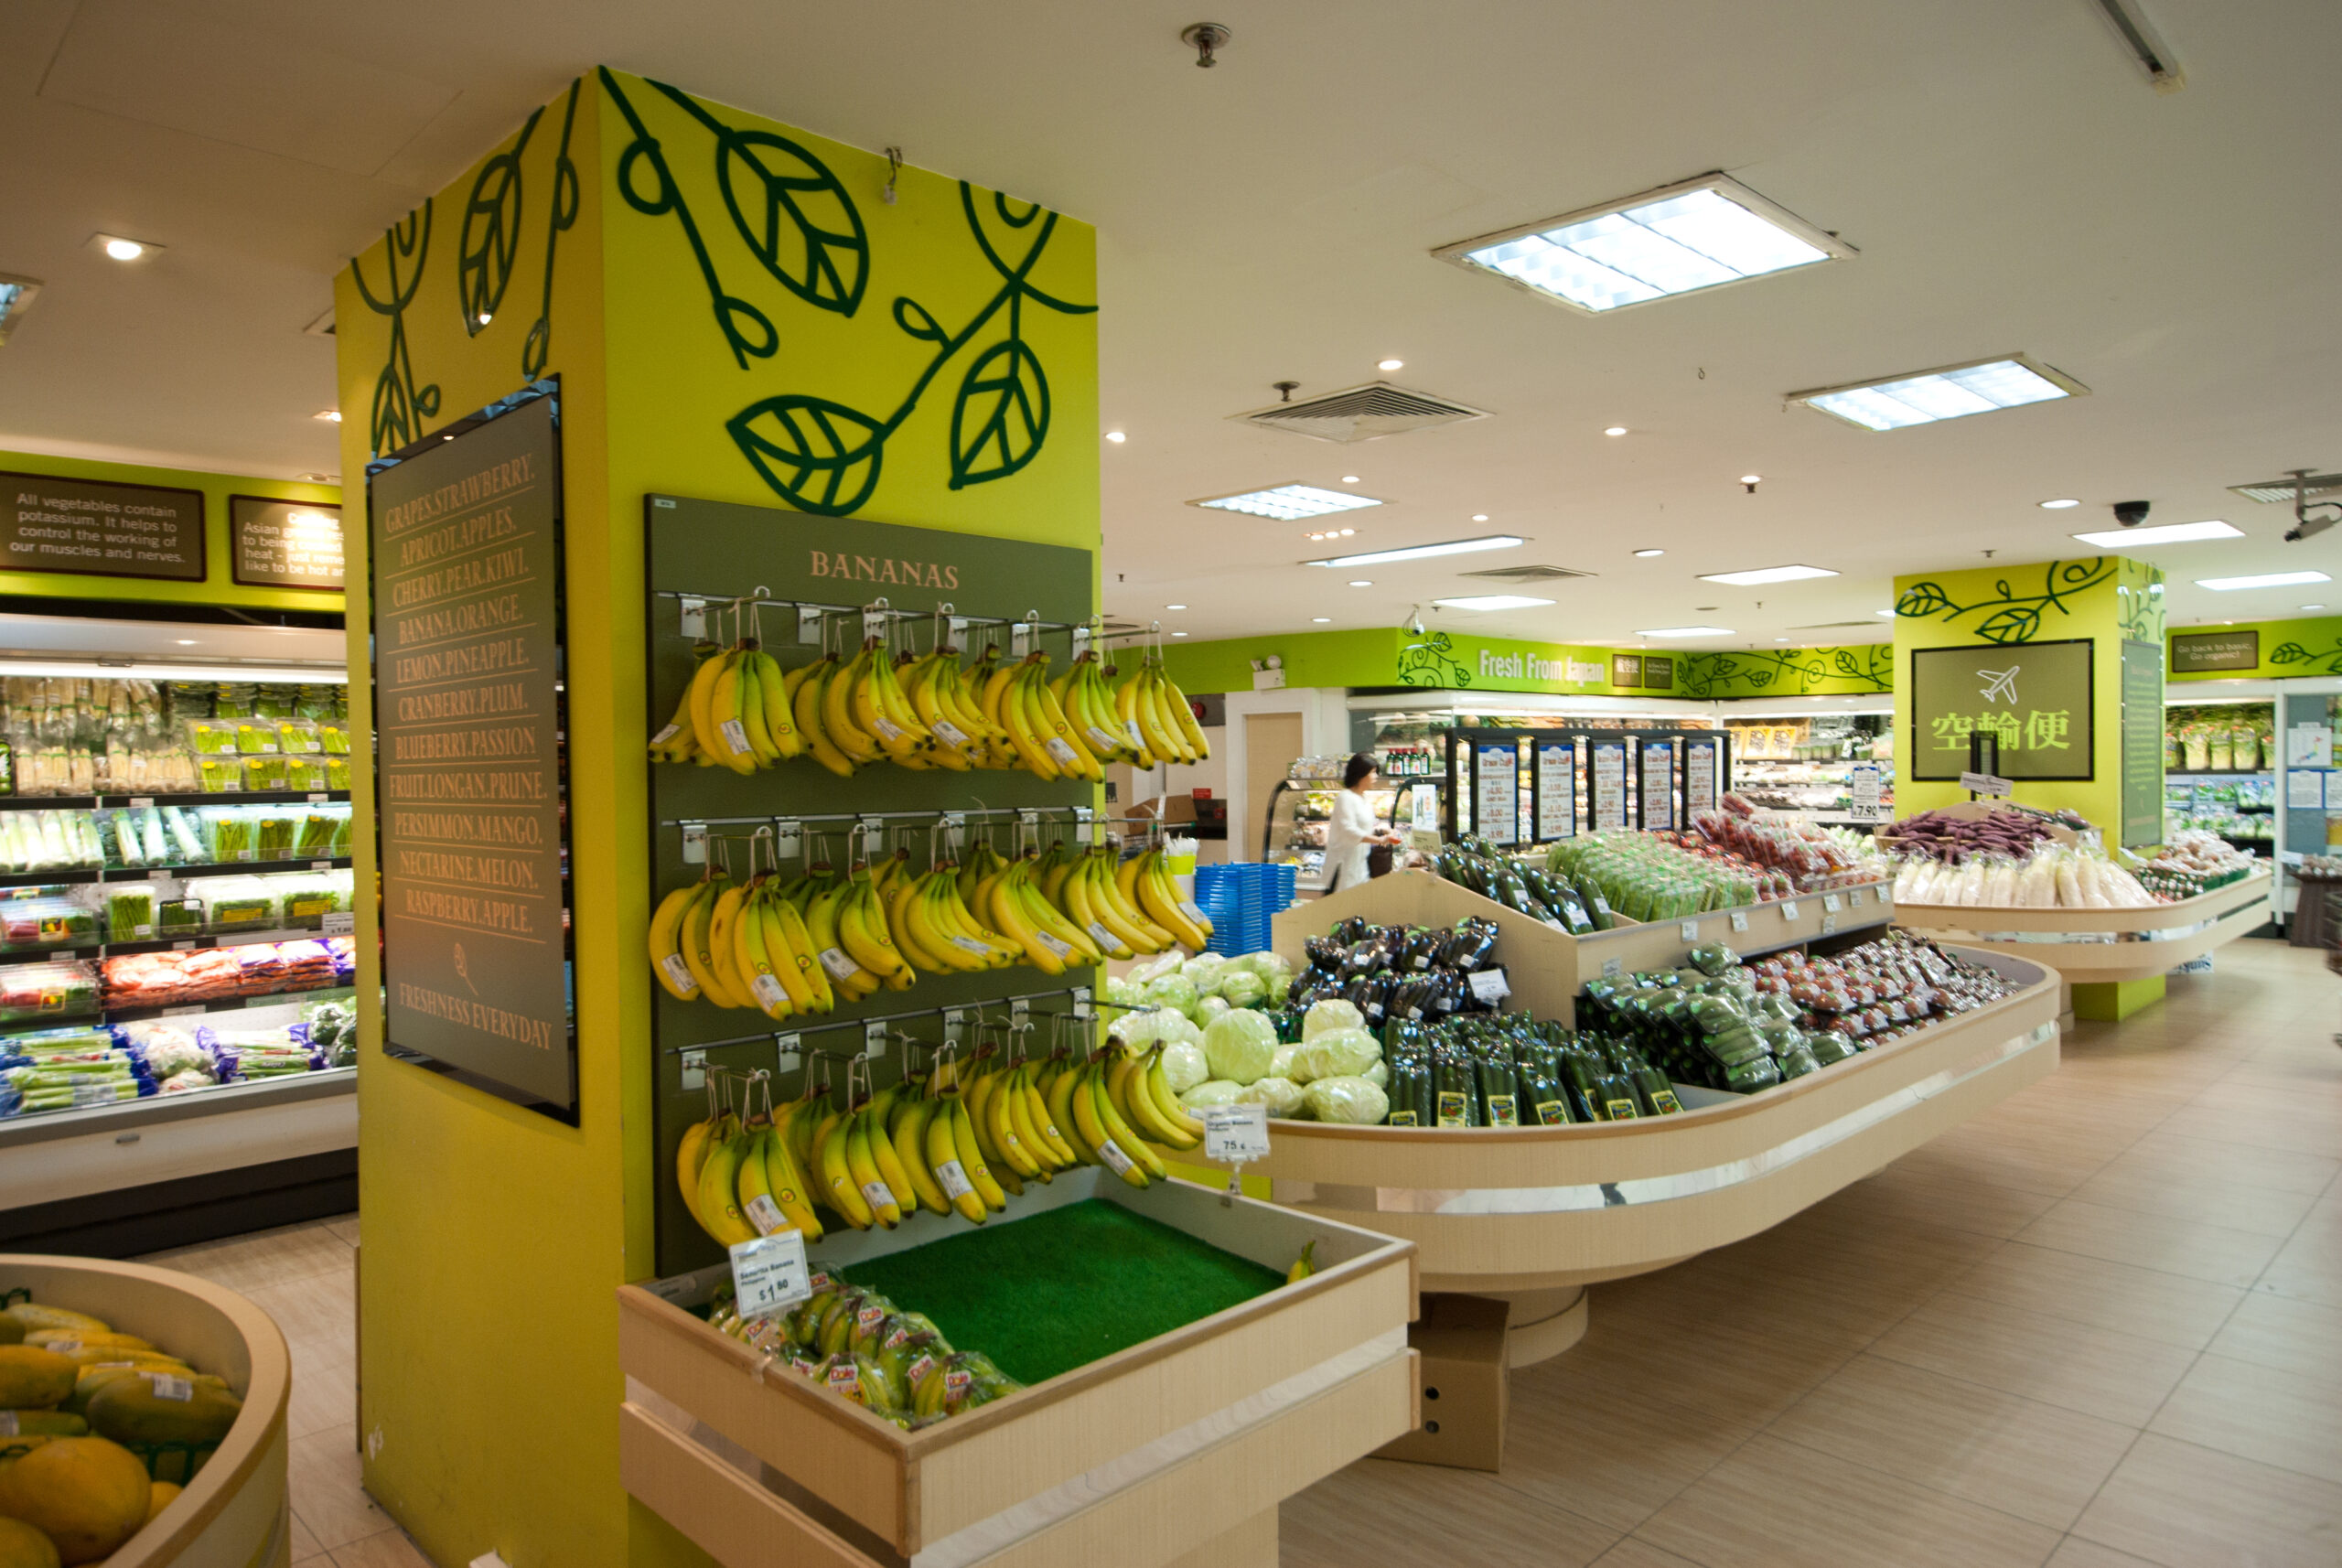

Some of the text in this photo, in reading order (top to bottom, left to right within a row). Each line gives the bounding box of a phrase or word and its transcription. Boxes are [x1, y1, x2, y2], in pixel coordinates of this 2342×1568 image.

[16, 493, 177, 518] All vegetables contain
[18, 510, 177, 532] potassium. It helps to
[243, 522, 279, 535] Asian
[18, 526, 177, 548] control the working of
[242, 535, 255, 545] to
[259, 536, 295, 551] being
[9, 542, 186, 563] our muscles and nerves.
[245, 548, 273, 560] heat
[245, 560, 269, 571] like
[272, 562, 285, 573] to
[289, 563, 306, 575] be
[308, 564, 328, 575] hot
[811, 551, 959, 590] BANANAS
[1479, 650, 1604, 687] Fresh From Japan
[399, 983, 470, 1029] FRESHNESS
[472, 1004, 553, 1050] EVERYDAY
[860, 1307, 881, 1323] Dole
[831, 1367, 854, 1380] Dole
[948, 1373, 968, 1387] Dole
